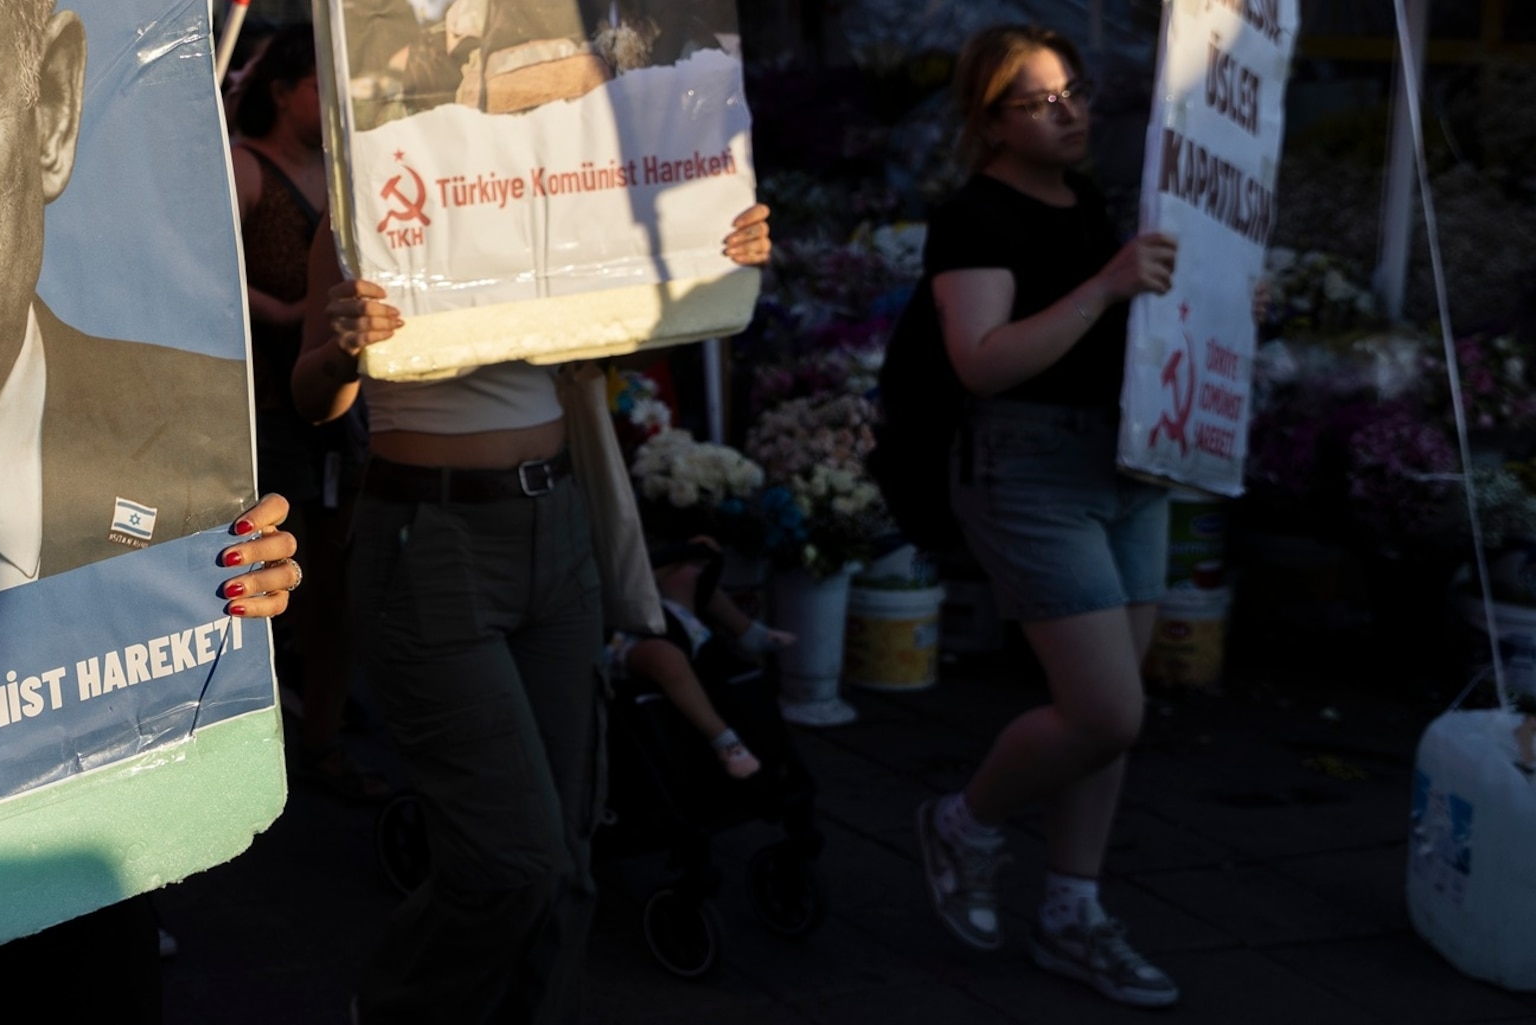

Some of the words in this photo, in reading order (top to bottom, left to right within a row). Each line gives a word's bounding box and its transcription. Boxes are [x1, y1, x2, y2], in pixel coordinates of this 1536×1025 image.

[1206, 28, 1261, 138] ÜSLER
[435, 173, 525, 210] Türkiye
[531, 159, 637, 198] Komünist
[641, 146, 739, 186] Hareketi
[1158, 127, 1276, 247] KAPATILSIN
[386, 227, 424, 250] TKH
